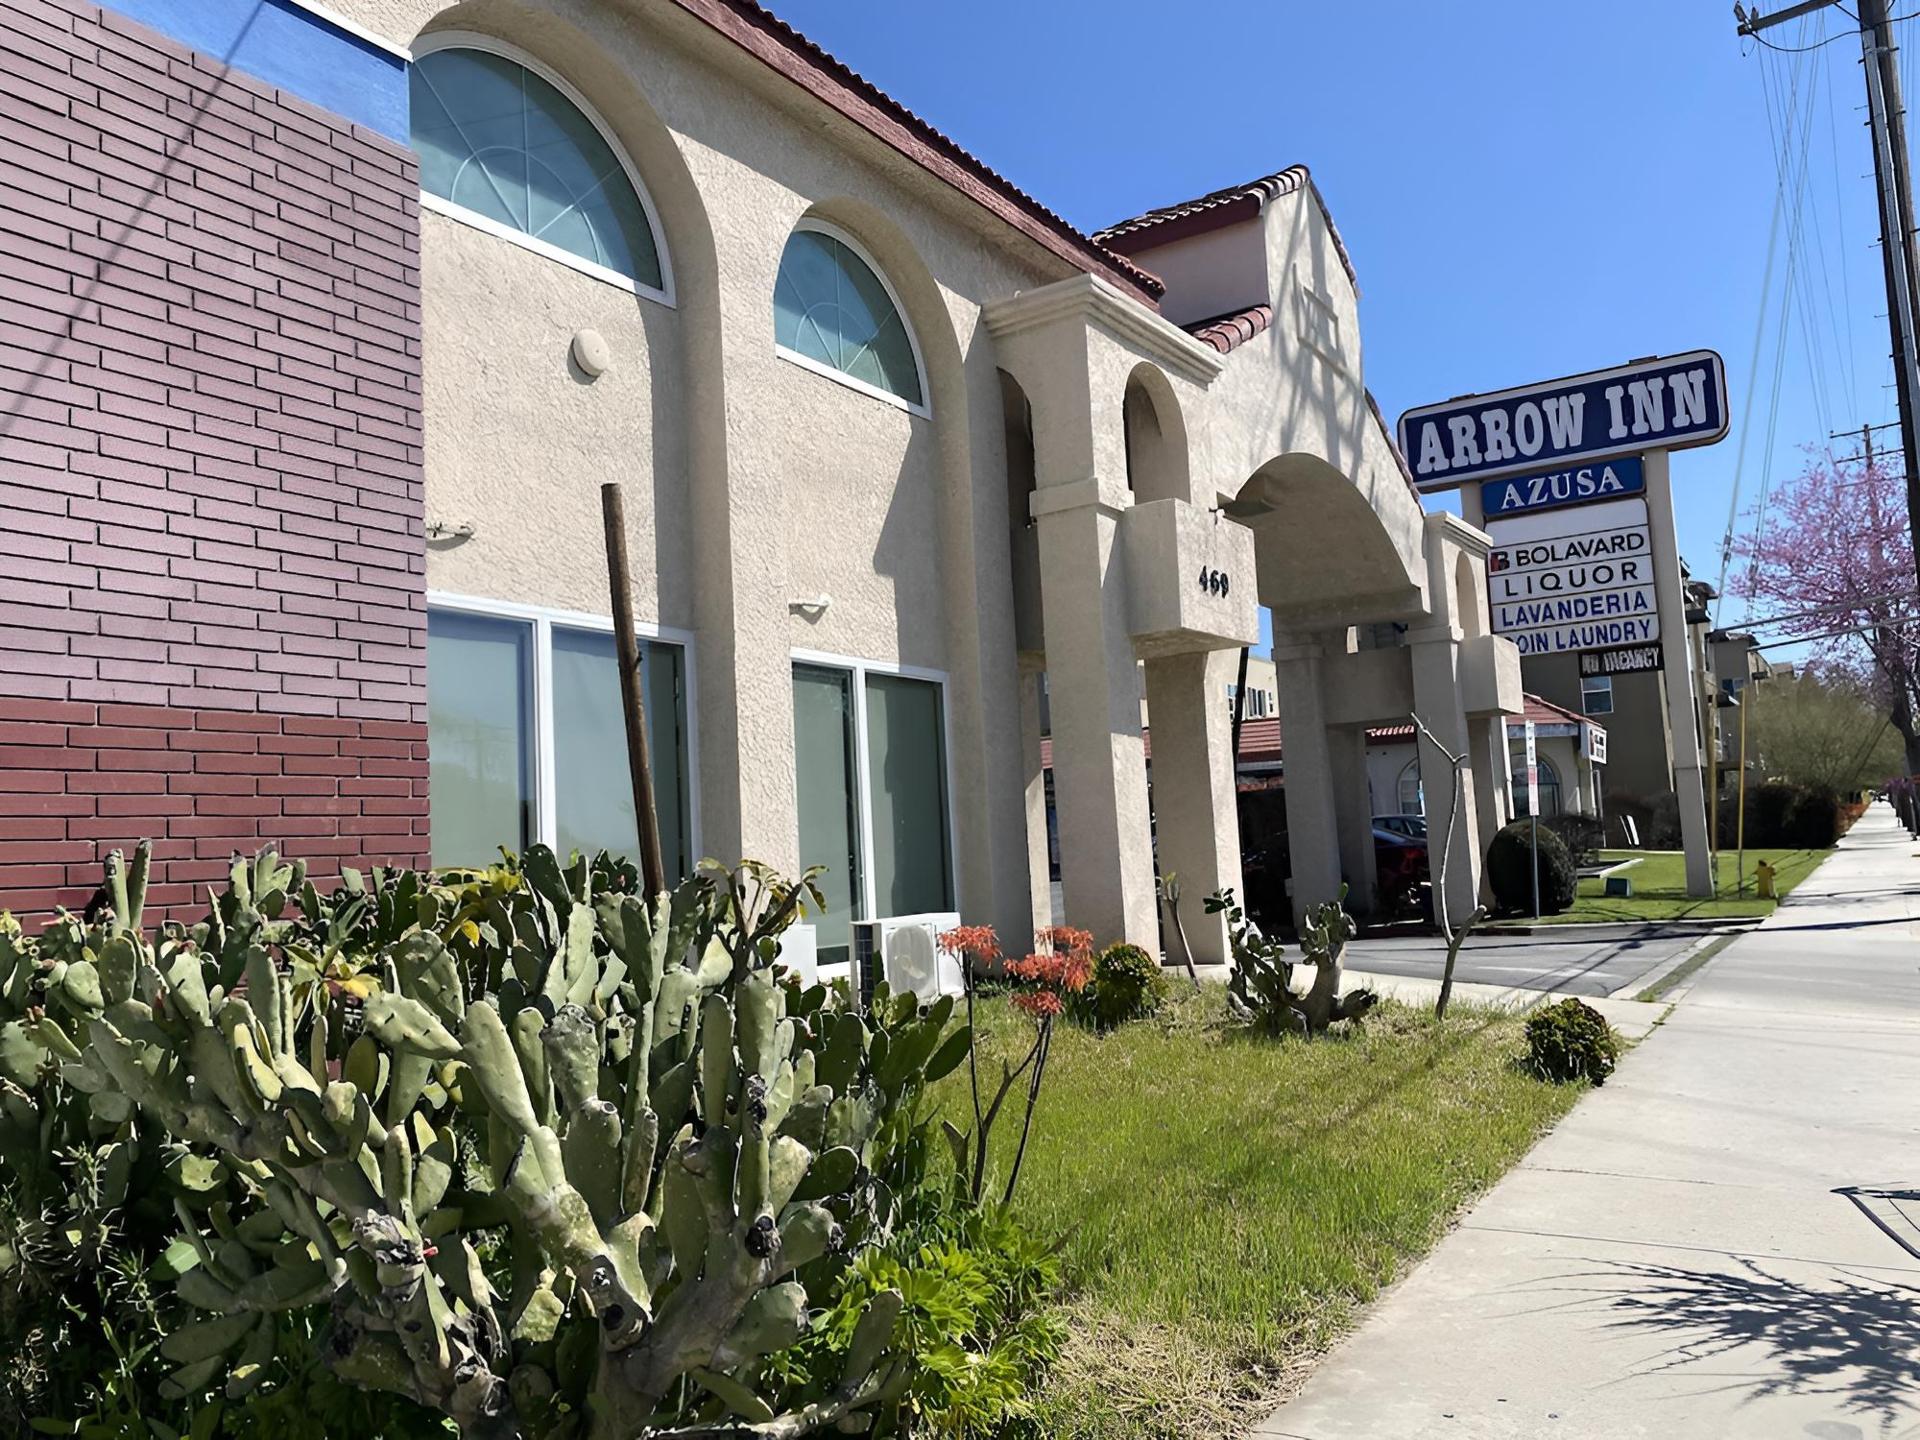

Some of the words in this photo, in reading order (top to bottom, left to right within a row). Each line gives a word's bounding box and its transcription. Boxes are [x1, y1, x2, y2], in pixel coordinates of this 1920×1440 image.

[1417, 393, 1585, 474] ARROW
[1605, 369, 1706, 439] INN
[1501, 466, 1624, 510] AZUSA
[1516, 533, 1645, 567] BOLAVARD
[1505, 561, 1637, 597] LIQUOR
[1502, 590, 1648, 627] LAVANDERIA
[1504, 632, 1549, 653] OIN
[1556, 619, 1651, 650] LAUNDRY
